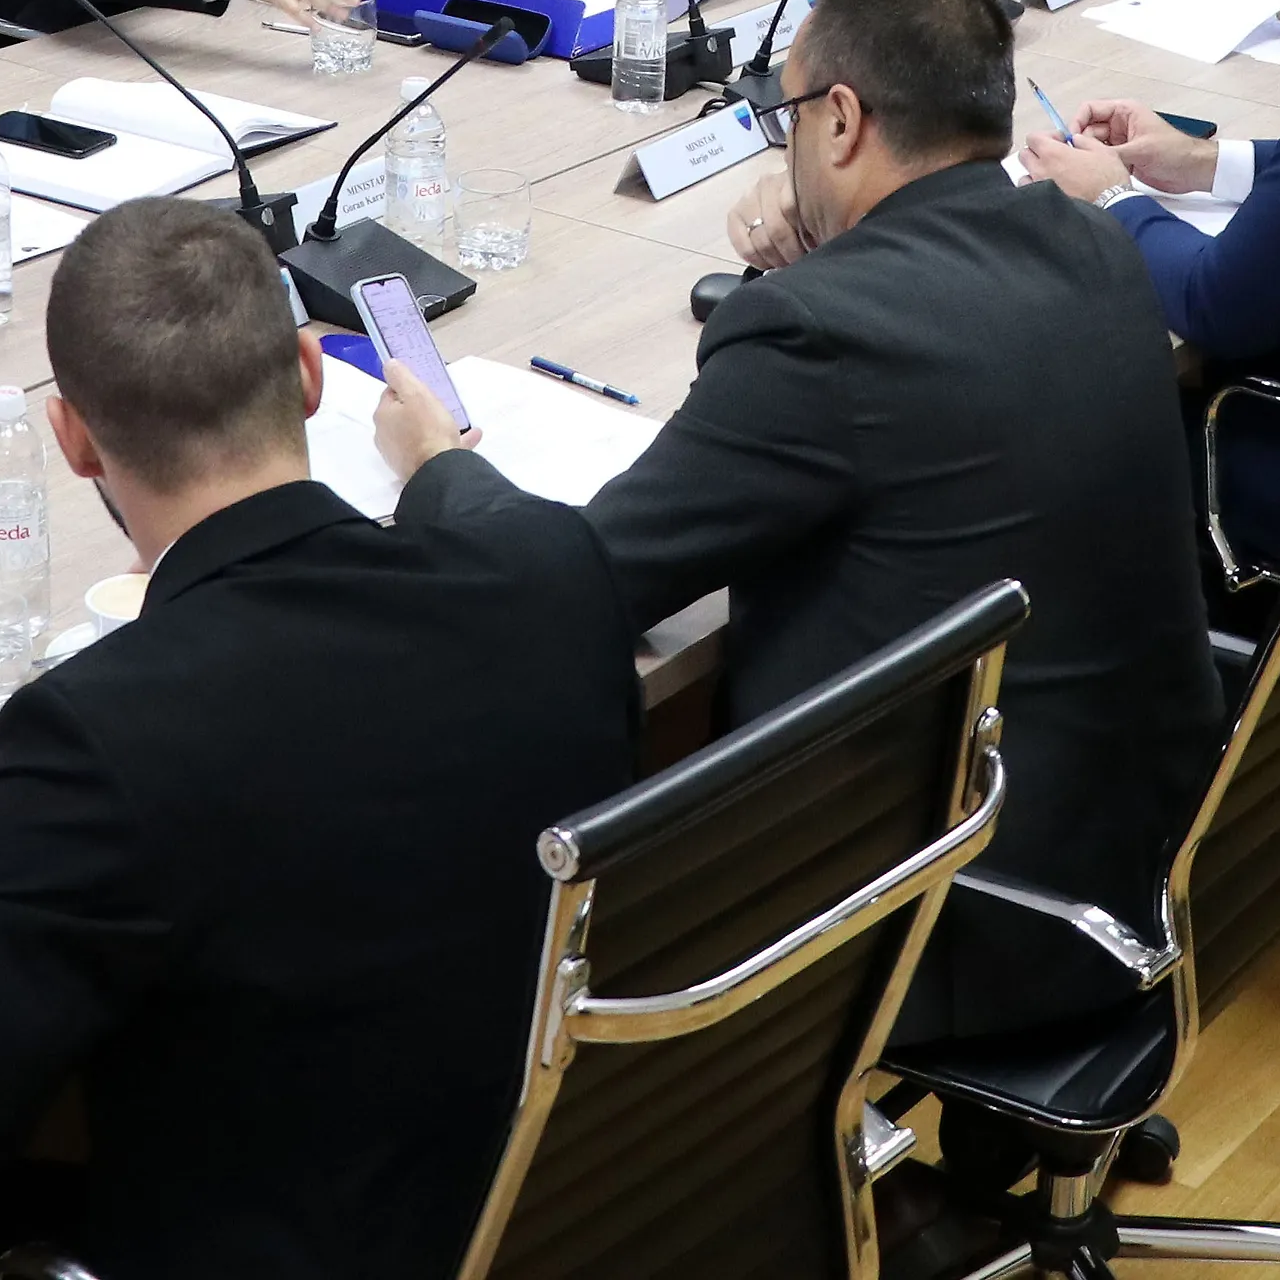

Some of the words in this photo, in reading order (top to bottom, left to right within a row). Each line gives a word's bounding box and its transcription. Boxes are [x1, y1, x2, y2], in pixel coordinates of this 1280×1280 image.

[346, 174, 386, 197] MINISTAR
[415, 181, 442, 198] leda
[342, 199, 365, 214] Goran
